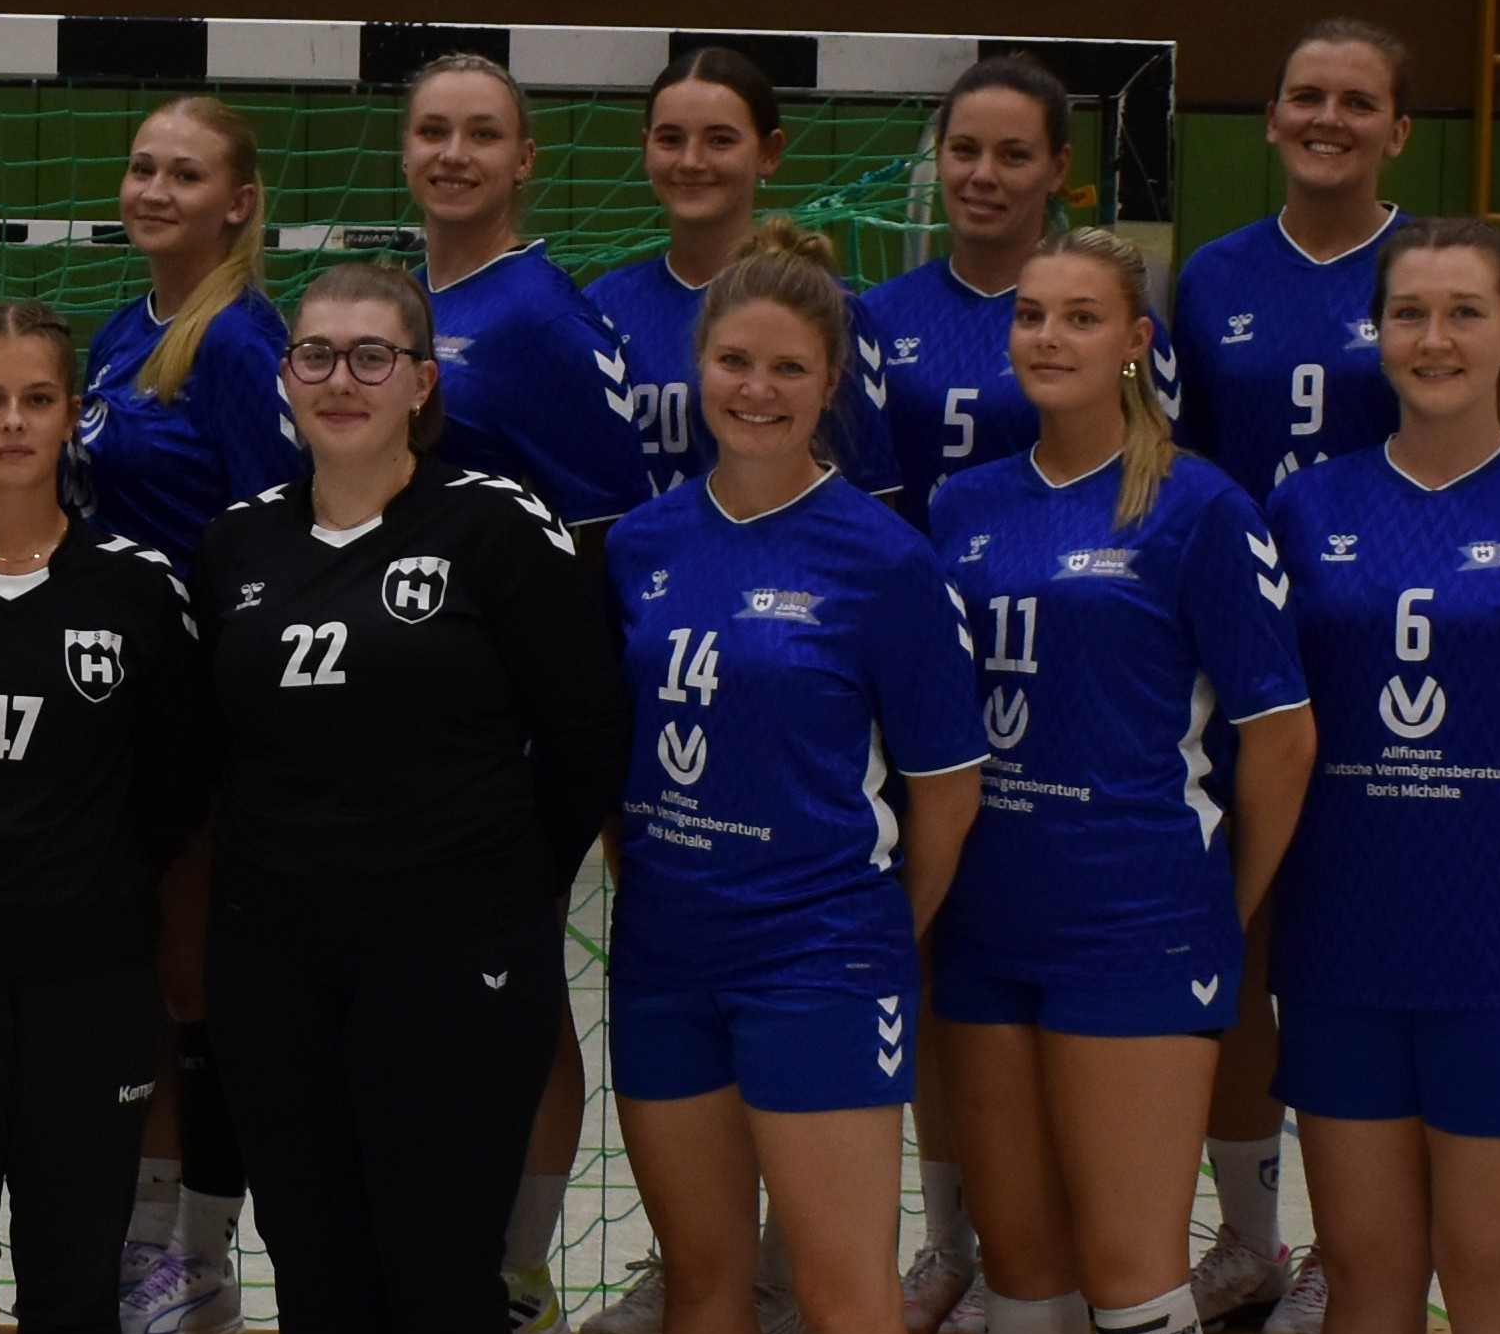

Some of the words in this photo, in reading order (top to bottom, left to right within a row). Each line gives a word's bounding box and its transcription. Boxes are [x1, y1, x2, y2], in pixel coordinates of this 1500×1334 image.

[632, 382, 689, 454] 20
[942, 388, 979, 458] 5
[1290, 363, 1325, 435] 9
[279, 620, 349, 688] 22
[984, 594, 1038, 674] 11
[1395, 587, 1435, 662] 6
[658, 627, 720, 706] 14
[1381, 746, 1443, 760] Allfinanz
[1366, 783, 1399, 797] Boris
[1401, 783, 1461, 799] Michalke
